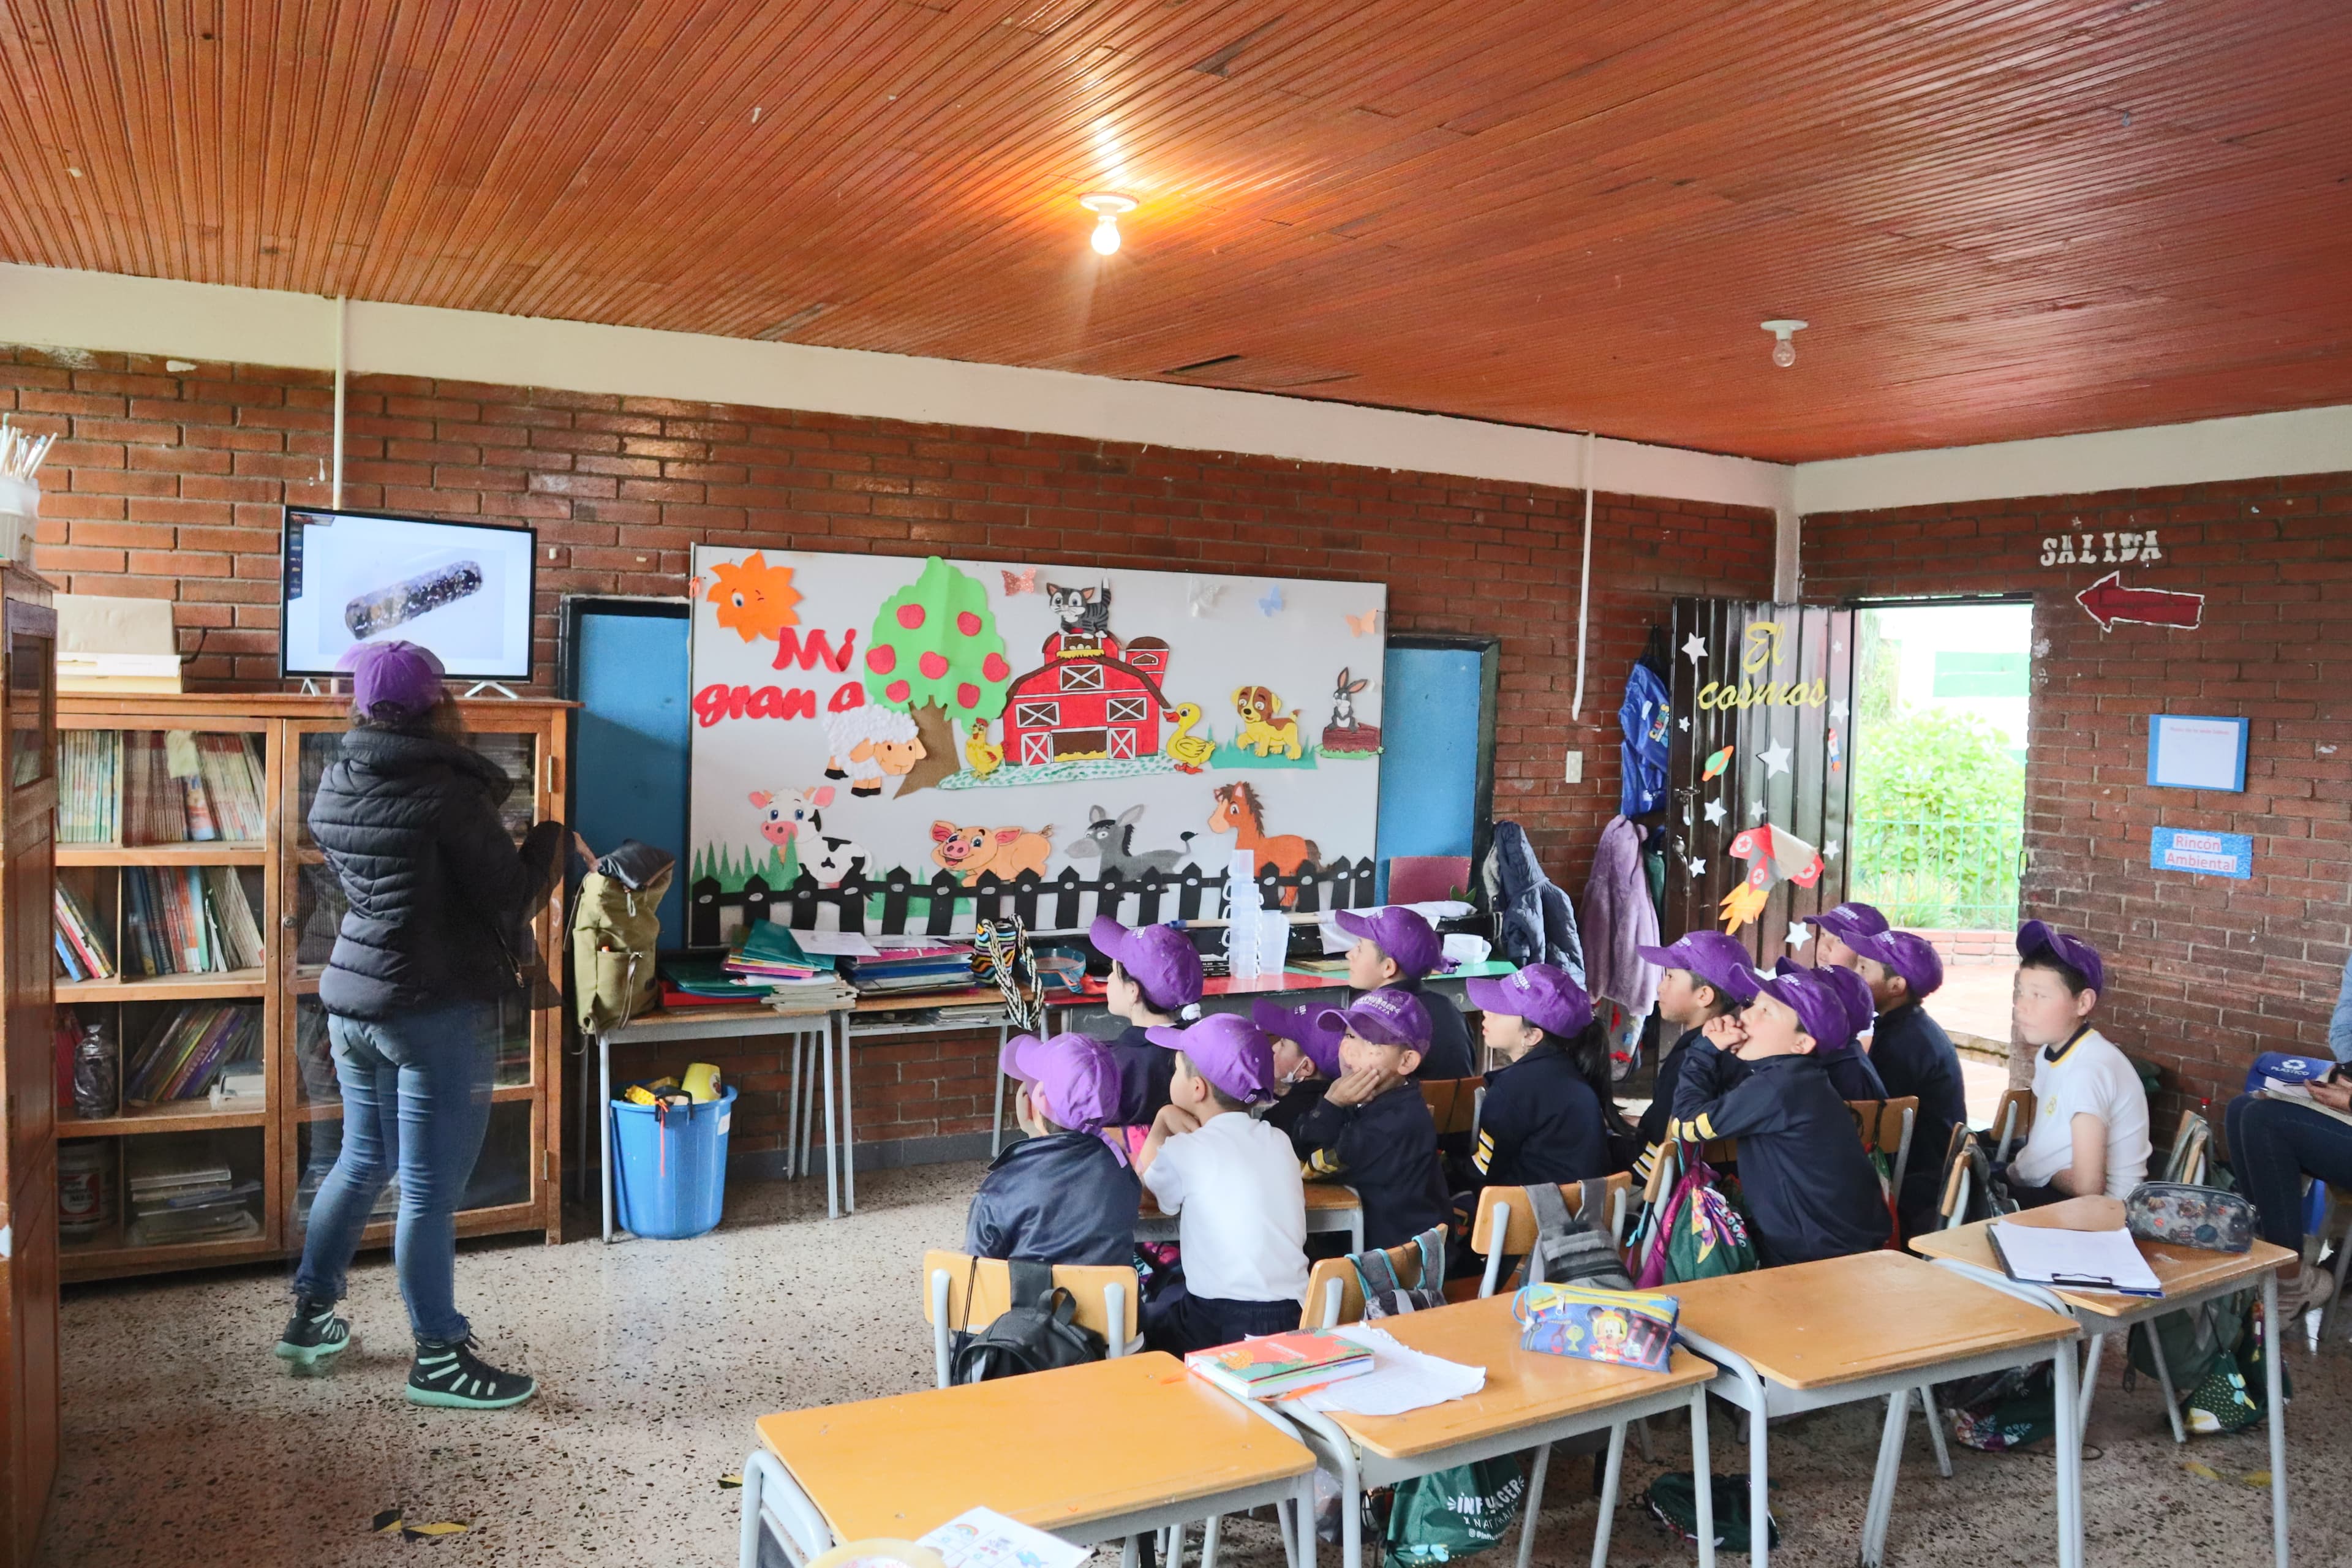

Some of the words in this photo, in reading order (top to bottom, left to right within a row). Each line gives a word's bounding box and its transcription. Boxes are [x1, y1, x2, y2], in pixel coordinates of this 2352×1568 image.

[2040, 530, 2162, 567] SALIDA
[772, 627, 856, 673] Mi
[1743, 621, 1785, 674] El
[1698, 677, 1828, 710] cosmos
[2176, 835, 2220, 851] Rincón
[2166, 852, 2235, 871] Ambiental
